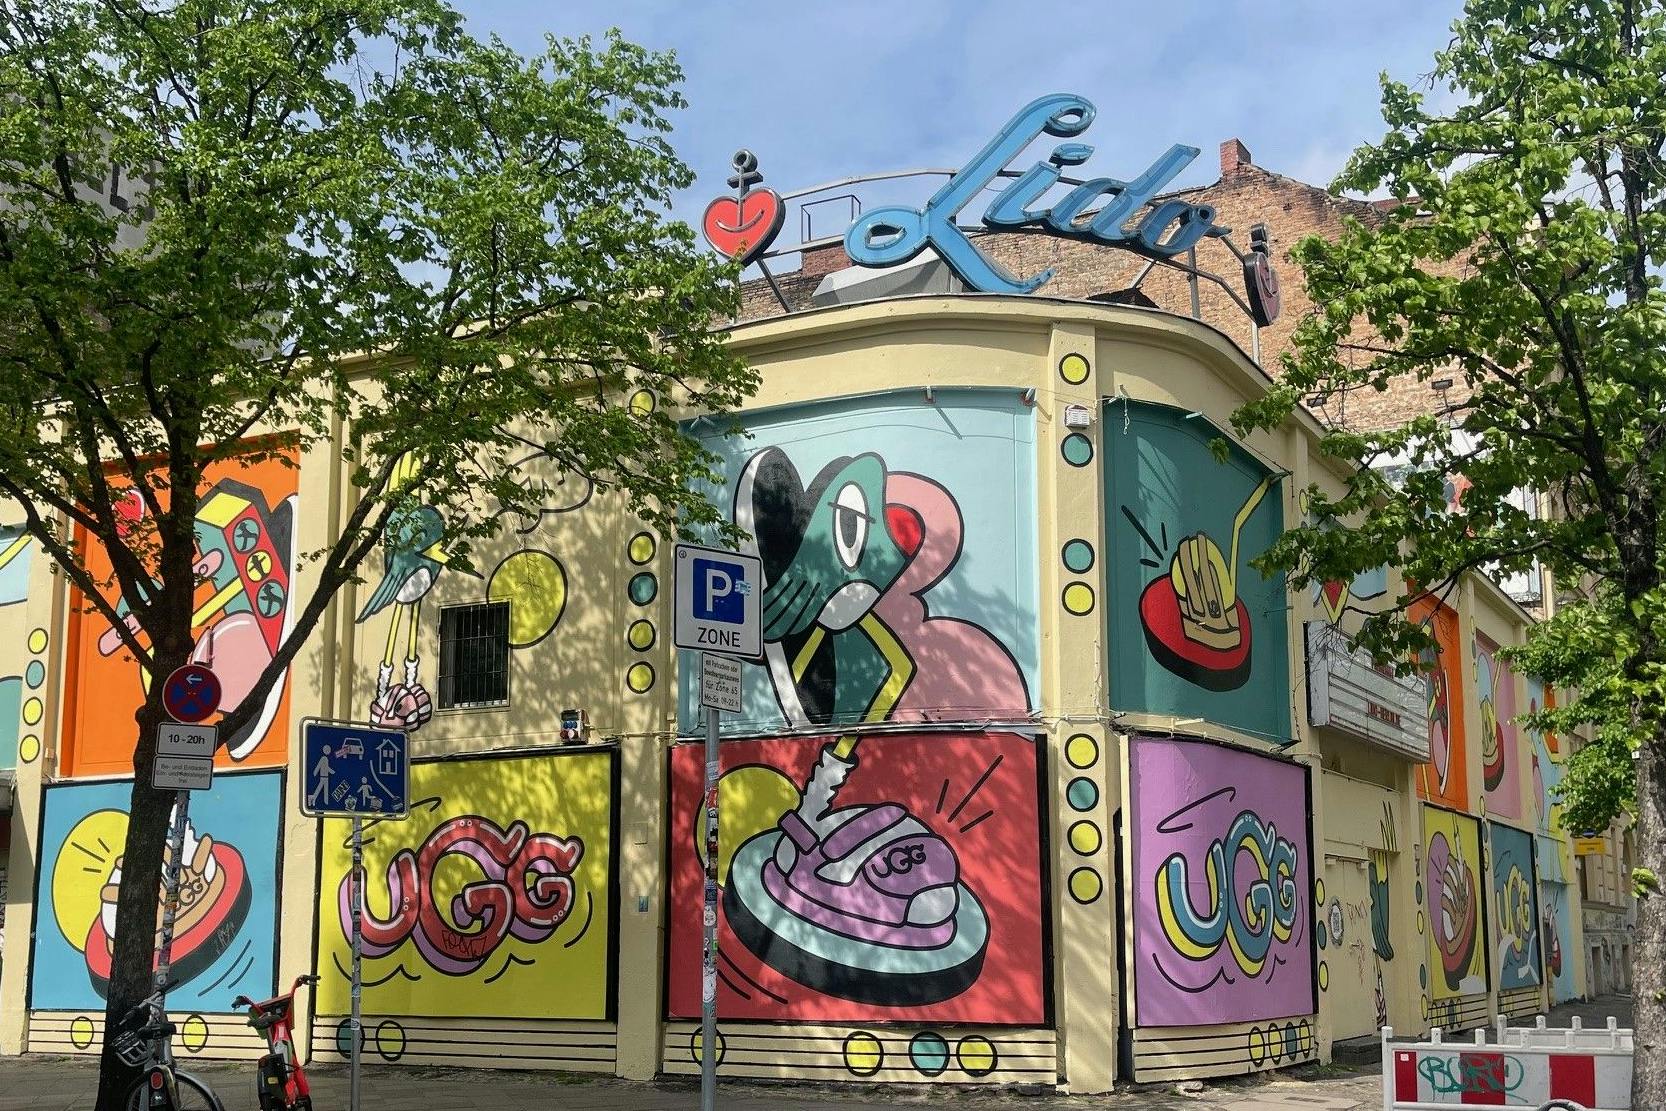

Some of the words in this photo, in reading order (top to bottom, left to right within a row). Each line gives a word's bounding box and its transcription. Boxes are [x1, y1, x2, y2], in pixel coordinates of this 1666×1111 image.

[843, 93, 1232, 295] Lido
[697, 626, 741, 648] ZONE
[706, 568, 732, 612] P
[338, 815, 584, 976] UGG
[871, 843, 927, 878] UGG
[1155, 809, 1298, 978] UGG
